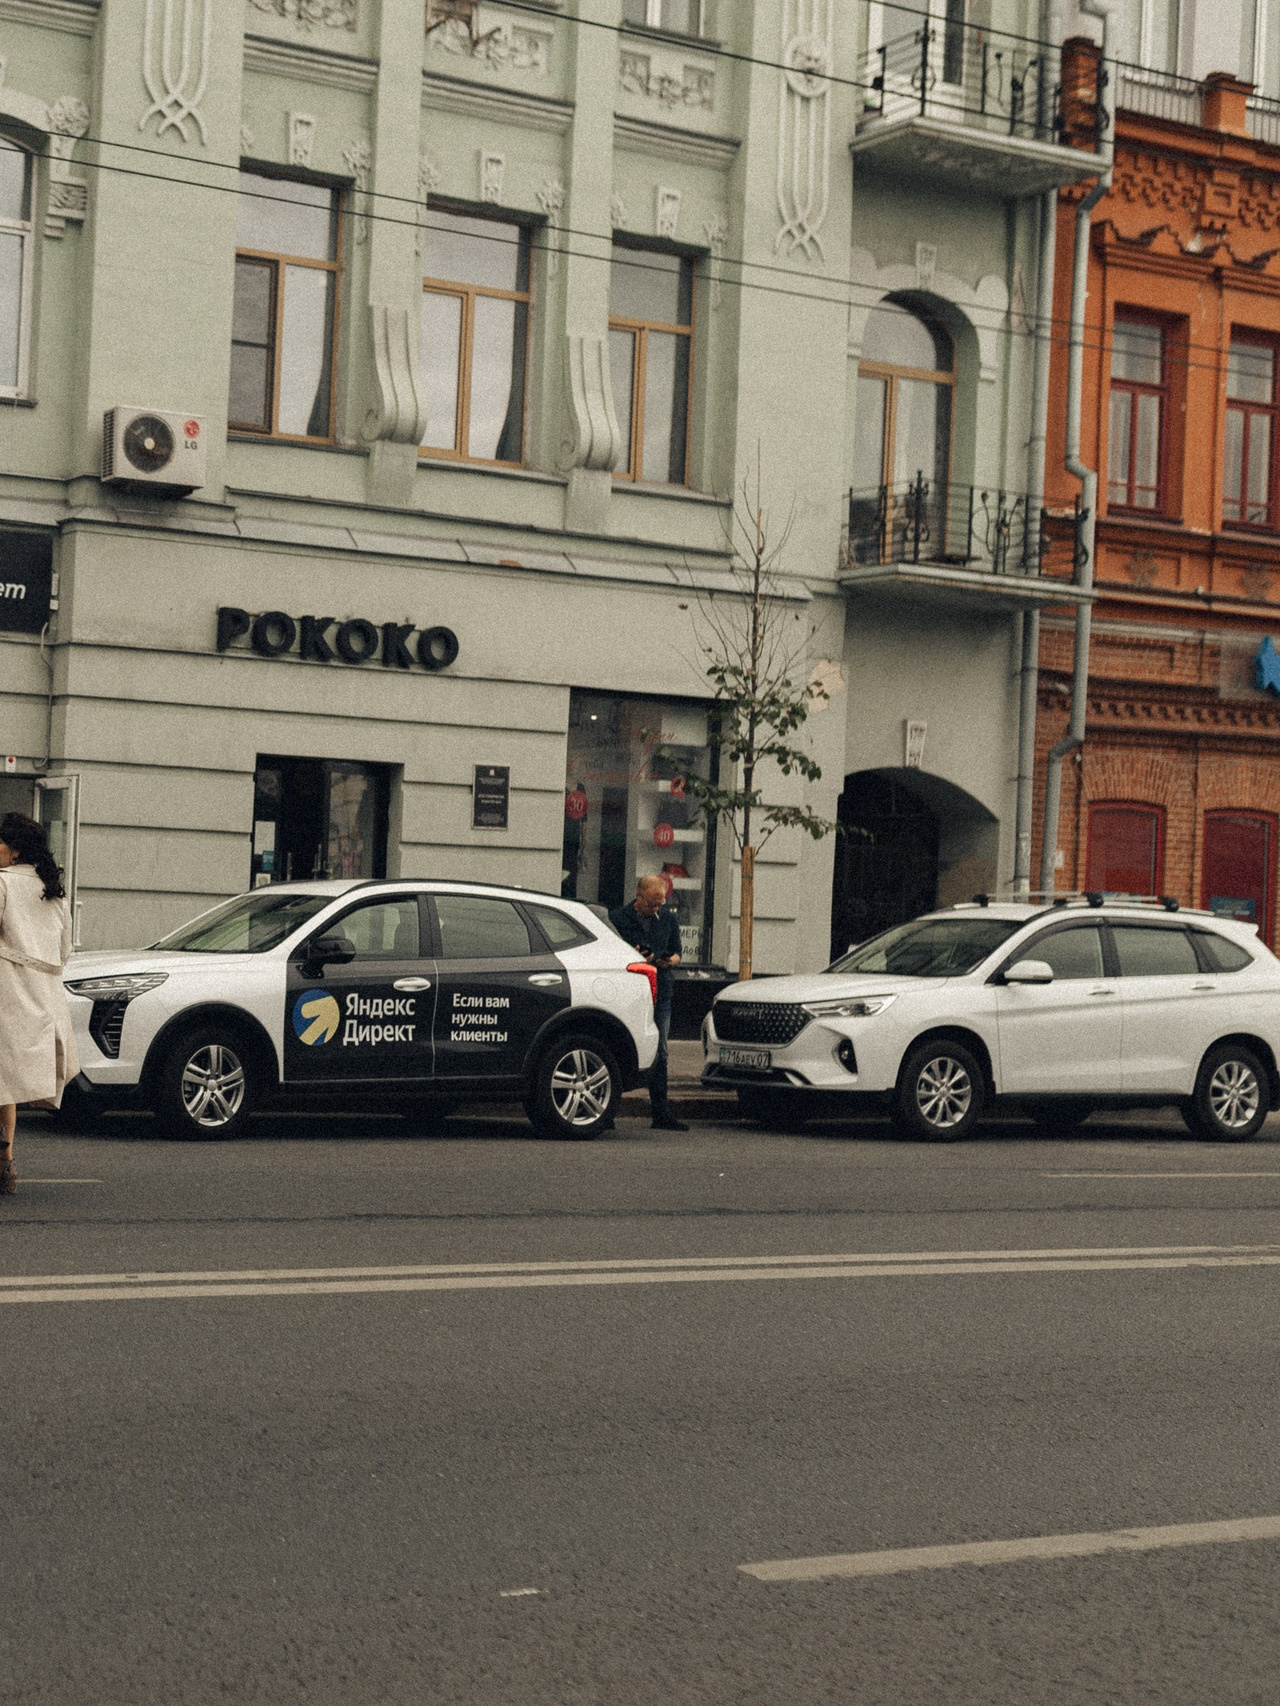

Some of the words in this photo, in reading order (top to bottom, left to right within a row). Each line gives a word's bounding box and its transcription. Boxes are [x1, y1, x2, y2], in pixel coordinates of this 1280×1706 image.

[184, 441, 198, 450] LG
[217, 607, 459, 671] РОКОКО
[345, 993, 416, 1016] Яндекс
[452, 993, 483, 1008] Если
[485, 996, 510, 1008] вам
[451, 1013, 498, 1026] нужны
[343, 1019, 416, 1045] Директ
[450, 1030, 508, 1042] клиенты
